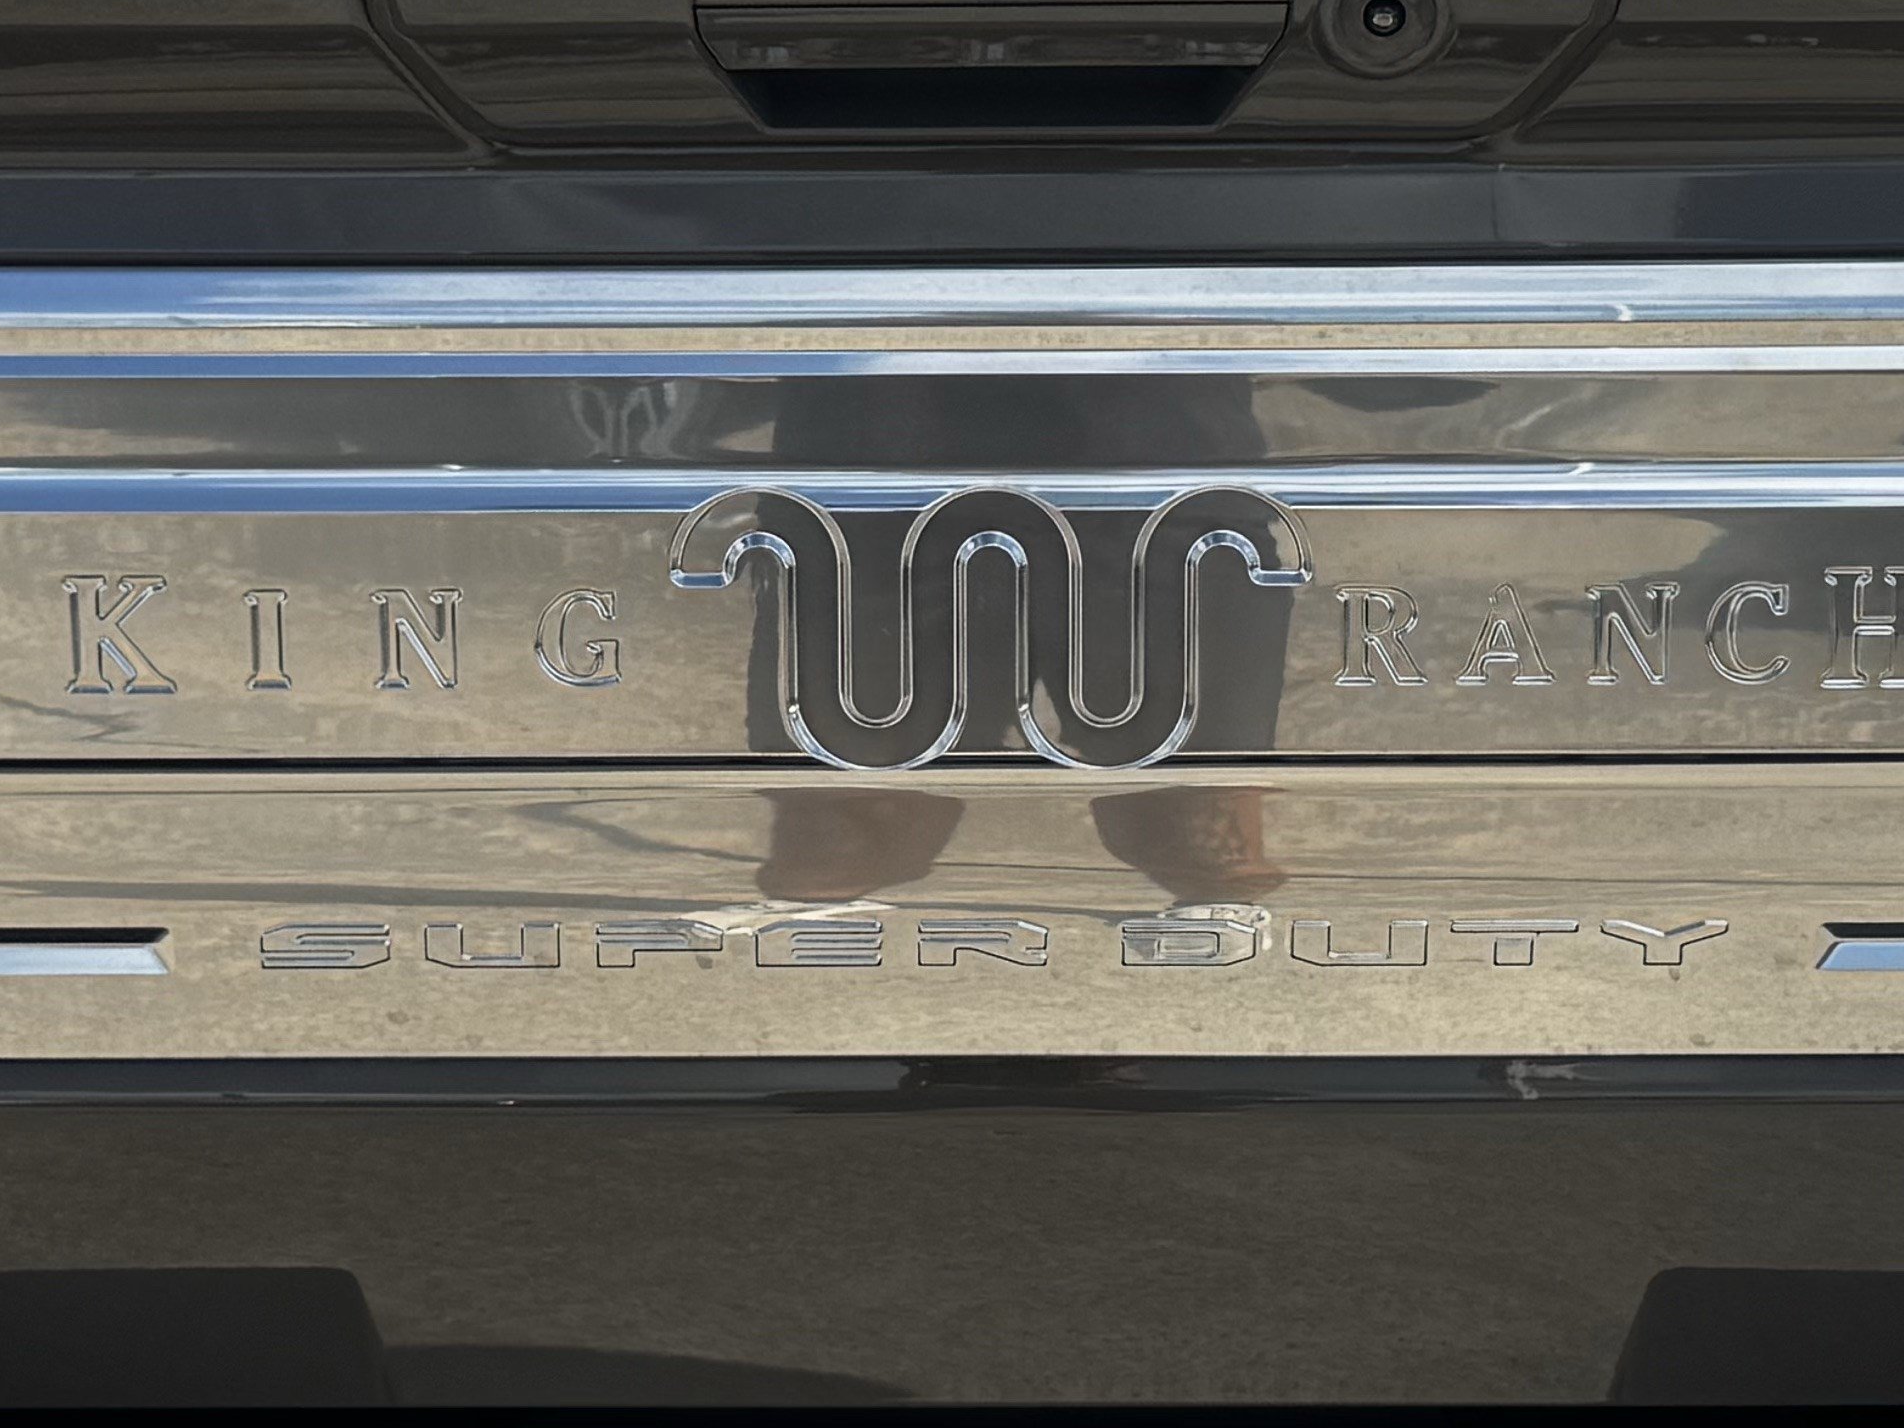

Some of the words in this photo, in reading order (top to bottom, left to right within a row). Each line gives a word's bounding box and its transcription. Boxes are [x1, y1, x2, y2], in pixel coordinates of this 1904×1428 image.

[60, 575, 623, 694] KING
[259, 921, 1049, 970] SUPER
[1120, 918, 1730, 968] DUTY
